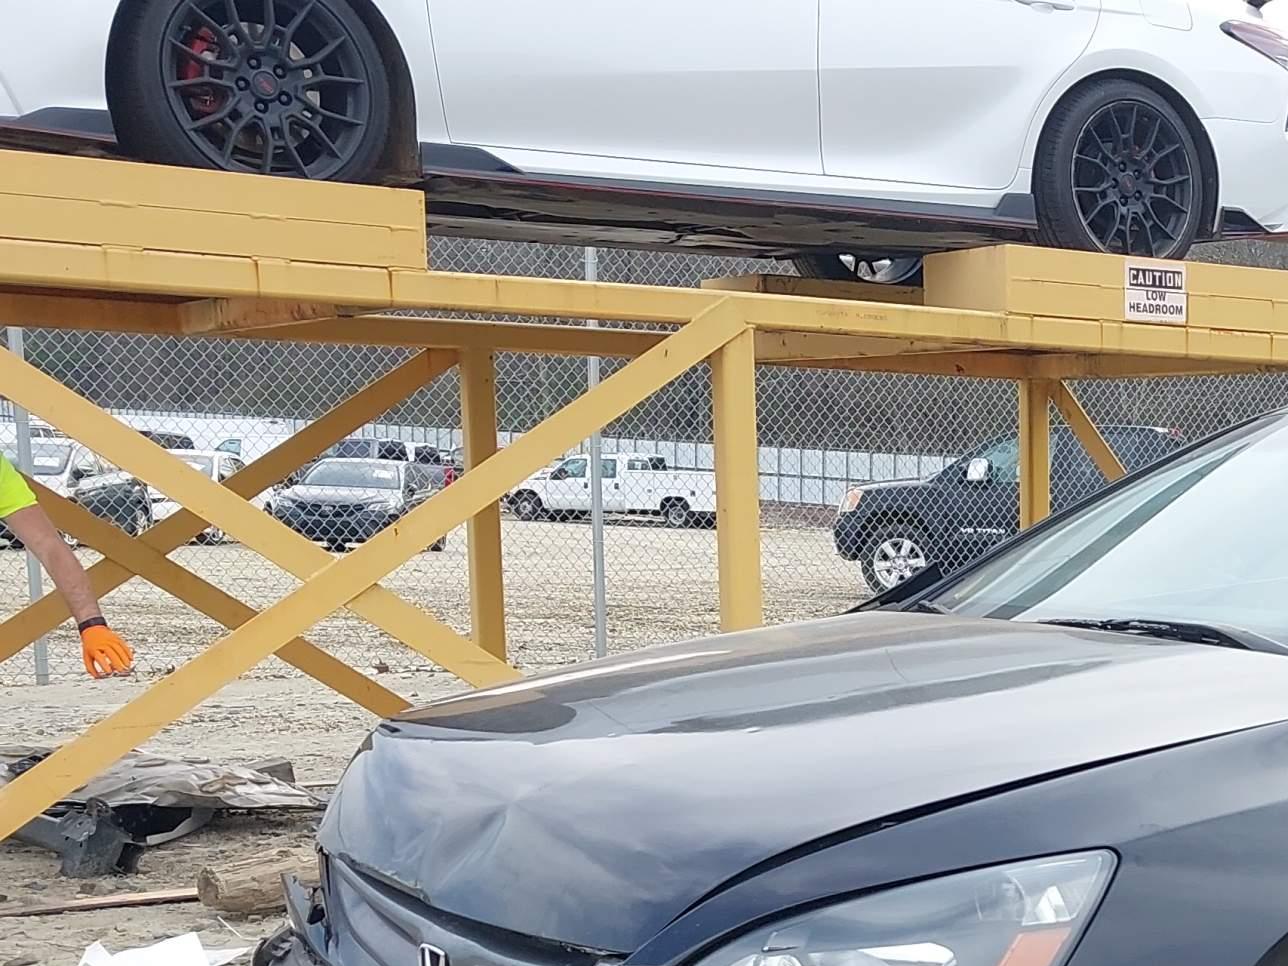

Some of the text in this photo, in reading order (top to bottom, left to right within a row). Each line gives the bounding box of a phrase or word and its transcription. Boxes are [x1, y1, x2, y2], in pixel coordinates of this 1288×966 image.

[1130, 269, 1182, 288] CAUTION
[1146, 290, 1167, 302] LOW
[1129, 302, 1183, 315] HEADROOM
